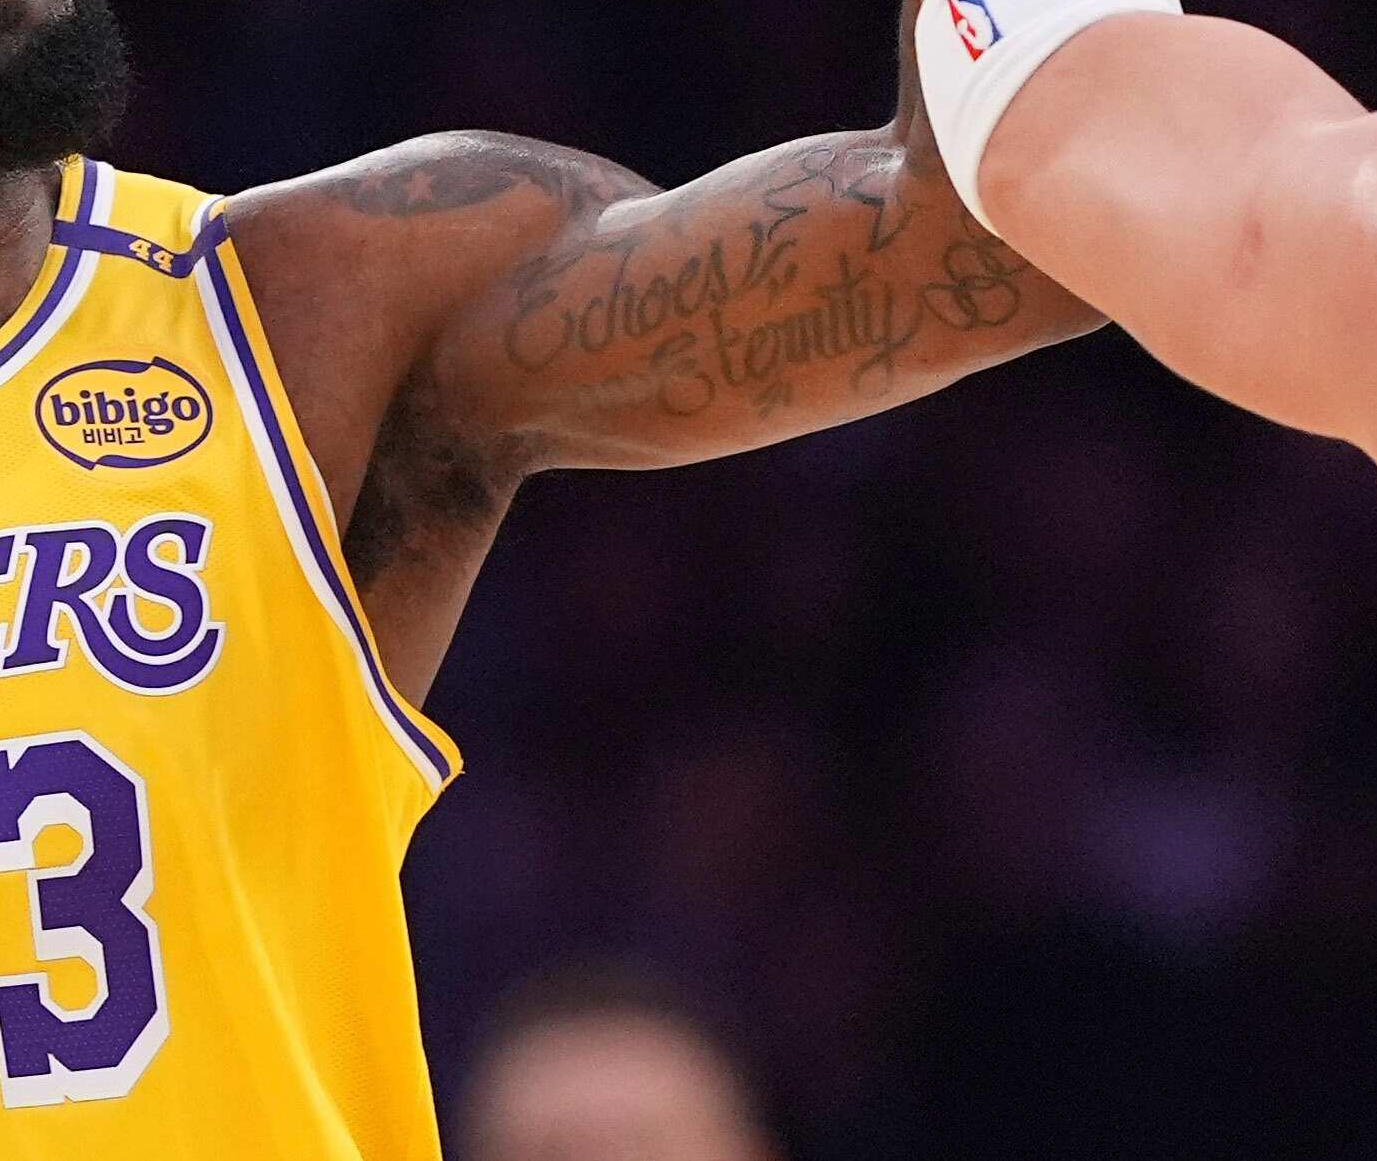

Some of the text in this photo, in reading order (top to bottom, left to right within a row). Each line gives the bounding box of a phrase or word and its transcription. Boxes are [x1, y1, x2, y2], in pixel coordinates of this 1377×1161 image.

[128, 239, 174, 273] 44
[504, 238, 729, 372] Echoes
[50, 387, 201, 435] bibigo
[82, 426, 146, 446] 비비고
